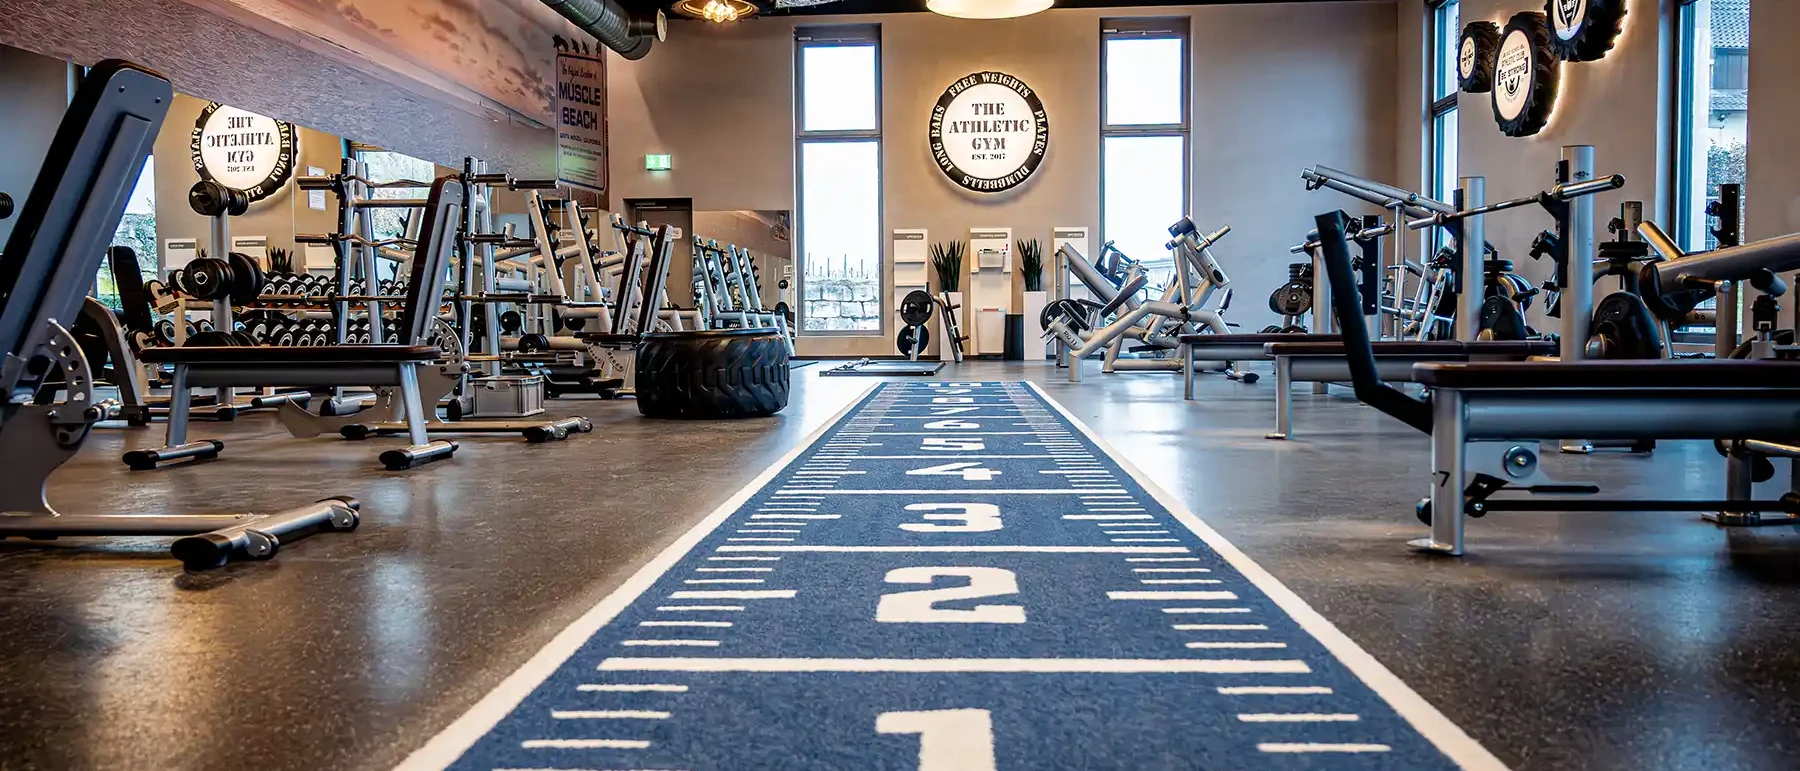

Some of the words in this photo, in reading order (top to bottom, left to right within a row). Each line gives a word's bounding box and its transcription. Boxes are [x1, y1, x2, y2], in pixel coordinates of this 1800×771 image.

[559, 82, 601, 107] MUSCLE
[948, 75, 978, 97] FREE
[981, 73, 1031, 97] WEIGHTS
[562, 107, 597, 130] BEACH
[971, 103, 1005, 115] THE
[931, 105, 945, 138] BARS
[949, 120, 1030, 133] ATHLETIC
[1034, 110, 1047, 155] PLATES
[971, 138, 1006, 150] GYM
[933, 143, 954, 172] LONG
[962, 165, 1030, 189] DUMBBELLS
[930, 406, 980, 415] 7
[923, 419, 980, 429] 6
[920, 437, 985, 450] 5
[905, 462, 1002, 480] 4
[898, 502, 1004, 532] 3
[876, 566, 1027, 623] 2
[875, 708, 997, 771] 1
